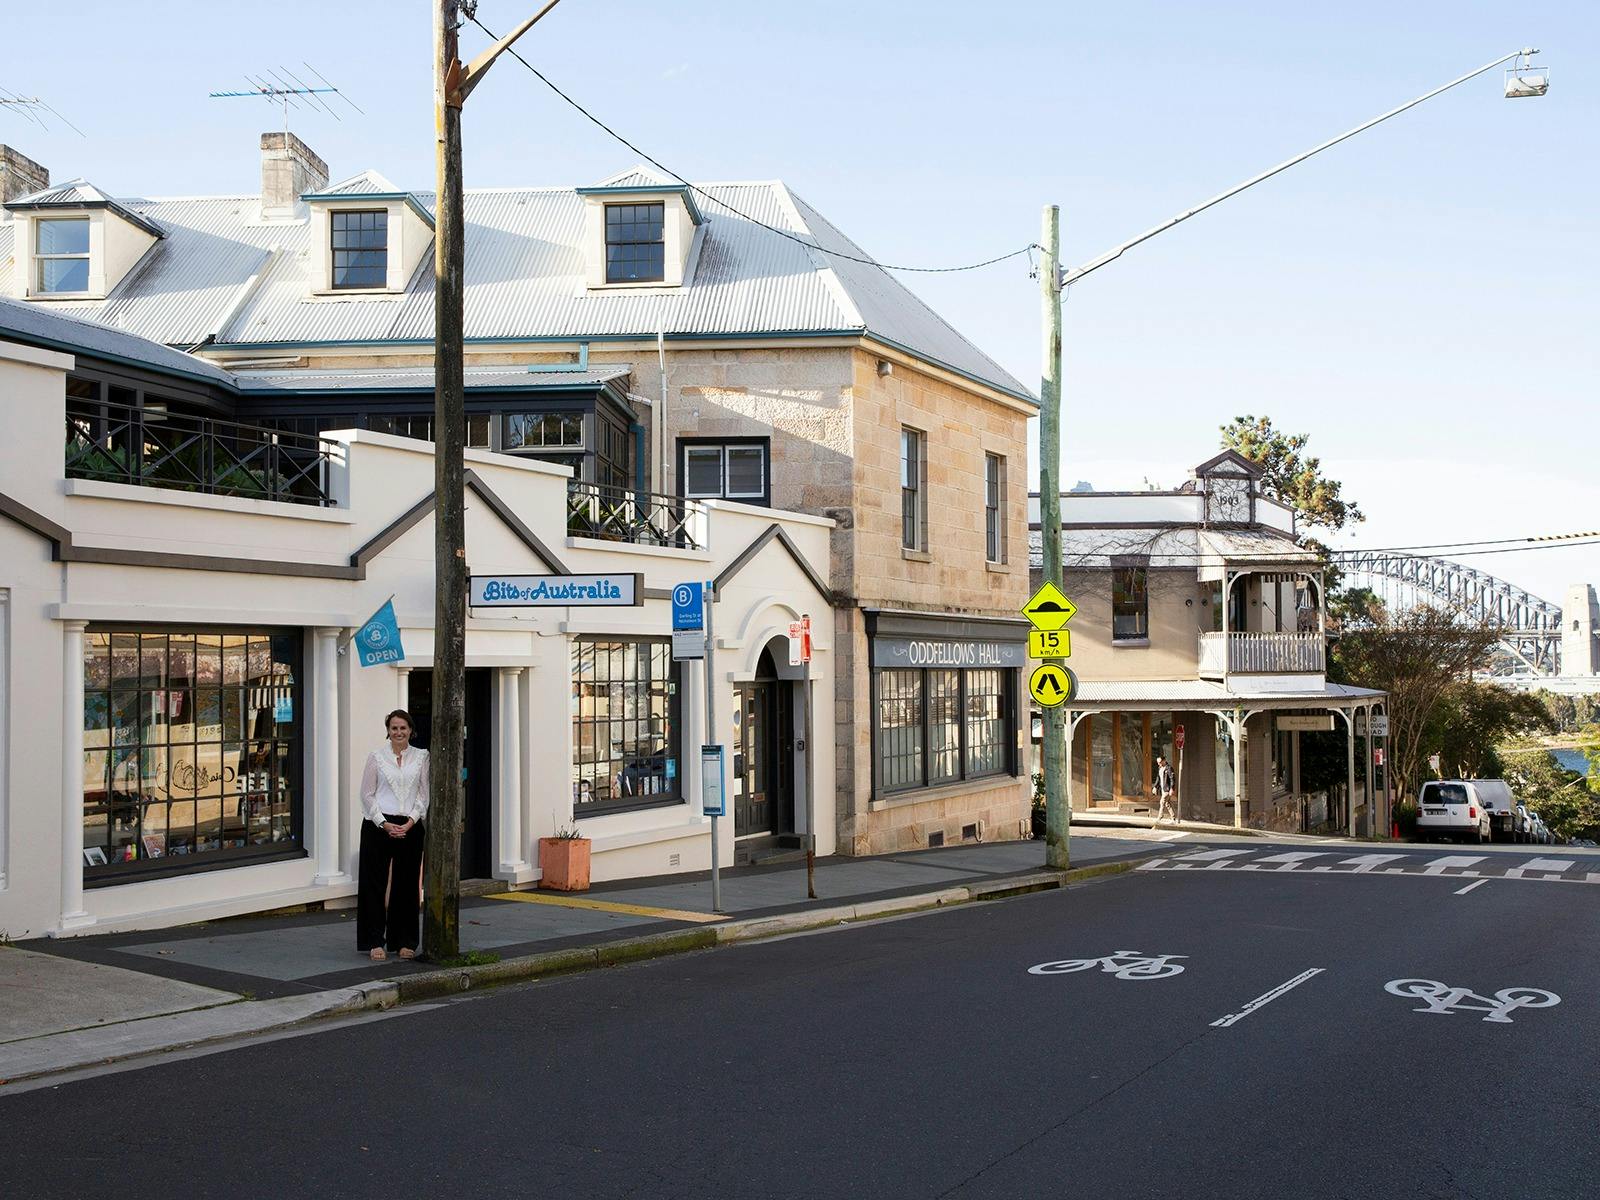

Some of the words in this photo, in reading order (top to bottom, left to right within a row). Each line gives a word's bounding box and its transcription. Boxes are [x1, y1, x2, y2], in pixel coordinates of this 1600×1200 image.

[1220, 496, 1239, 505] 1903
[483, 581, 520, 601] Bits
[520, 587, 531, 600] of
[530, 580, 621, 600] Australia
[679, 591, 688, 602] B
[1040, 632, 1059, 648] 15
[366, 649, 398, 663] OPEN
[909, 641, 975, 665] ODDFELLOWS
[979, 644, 1001, 664] HALL
[1040, 648, 1060, 656] km/h
